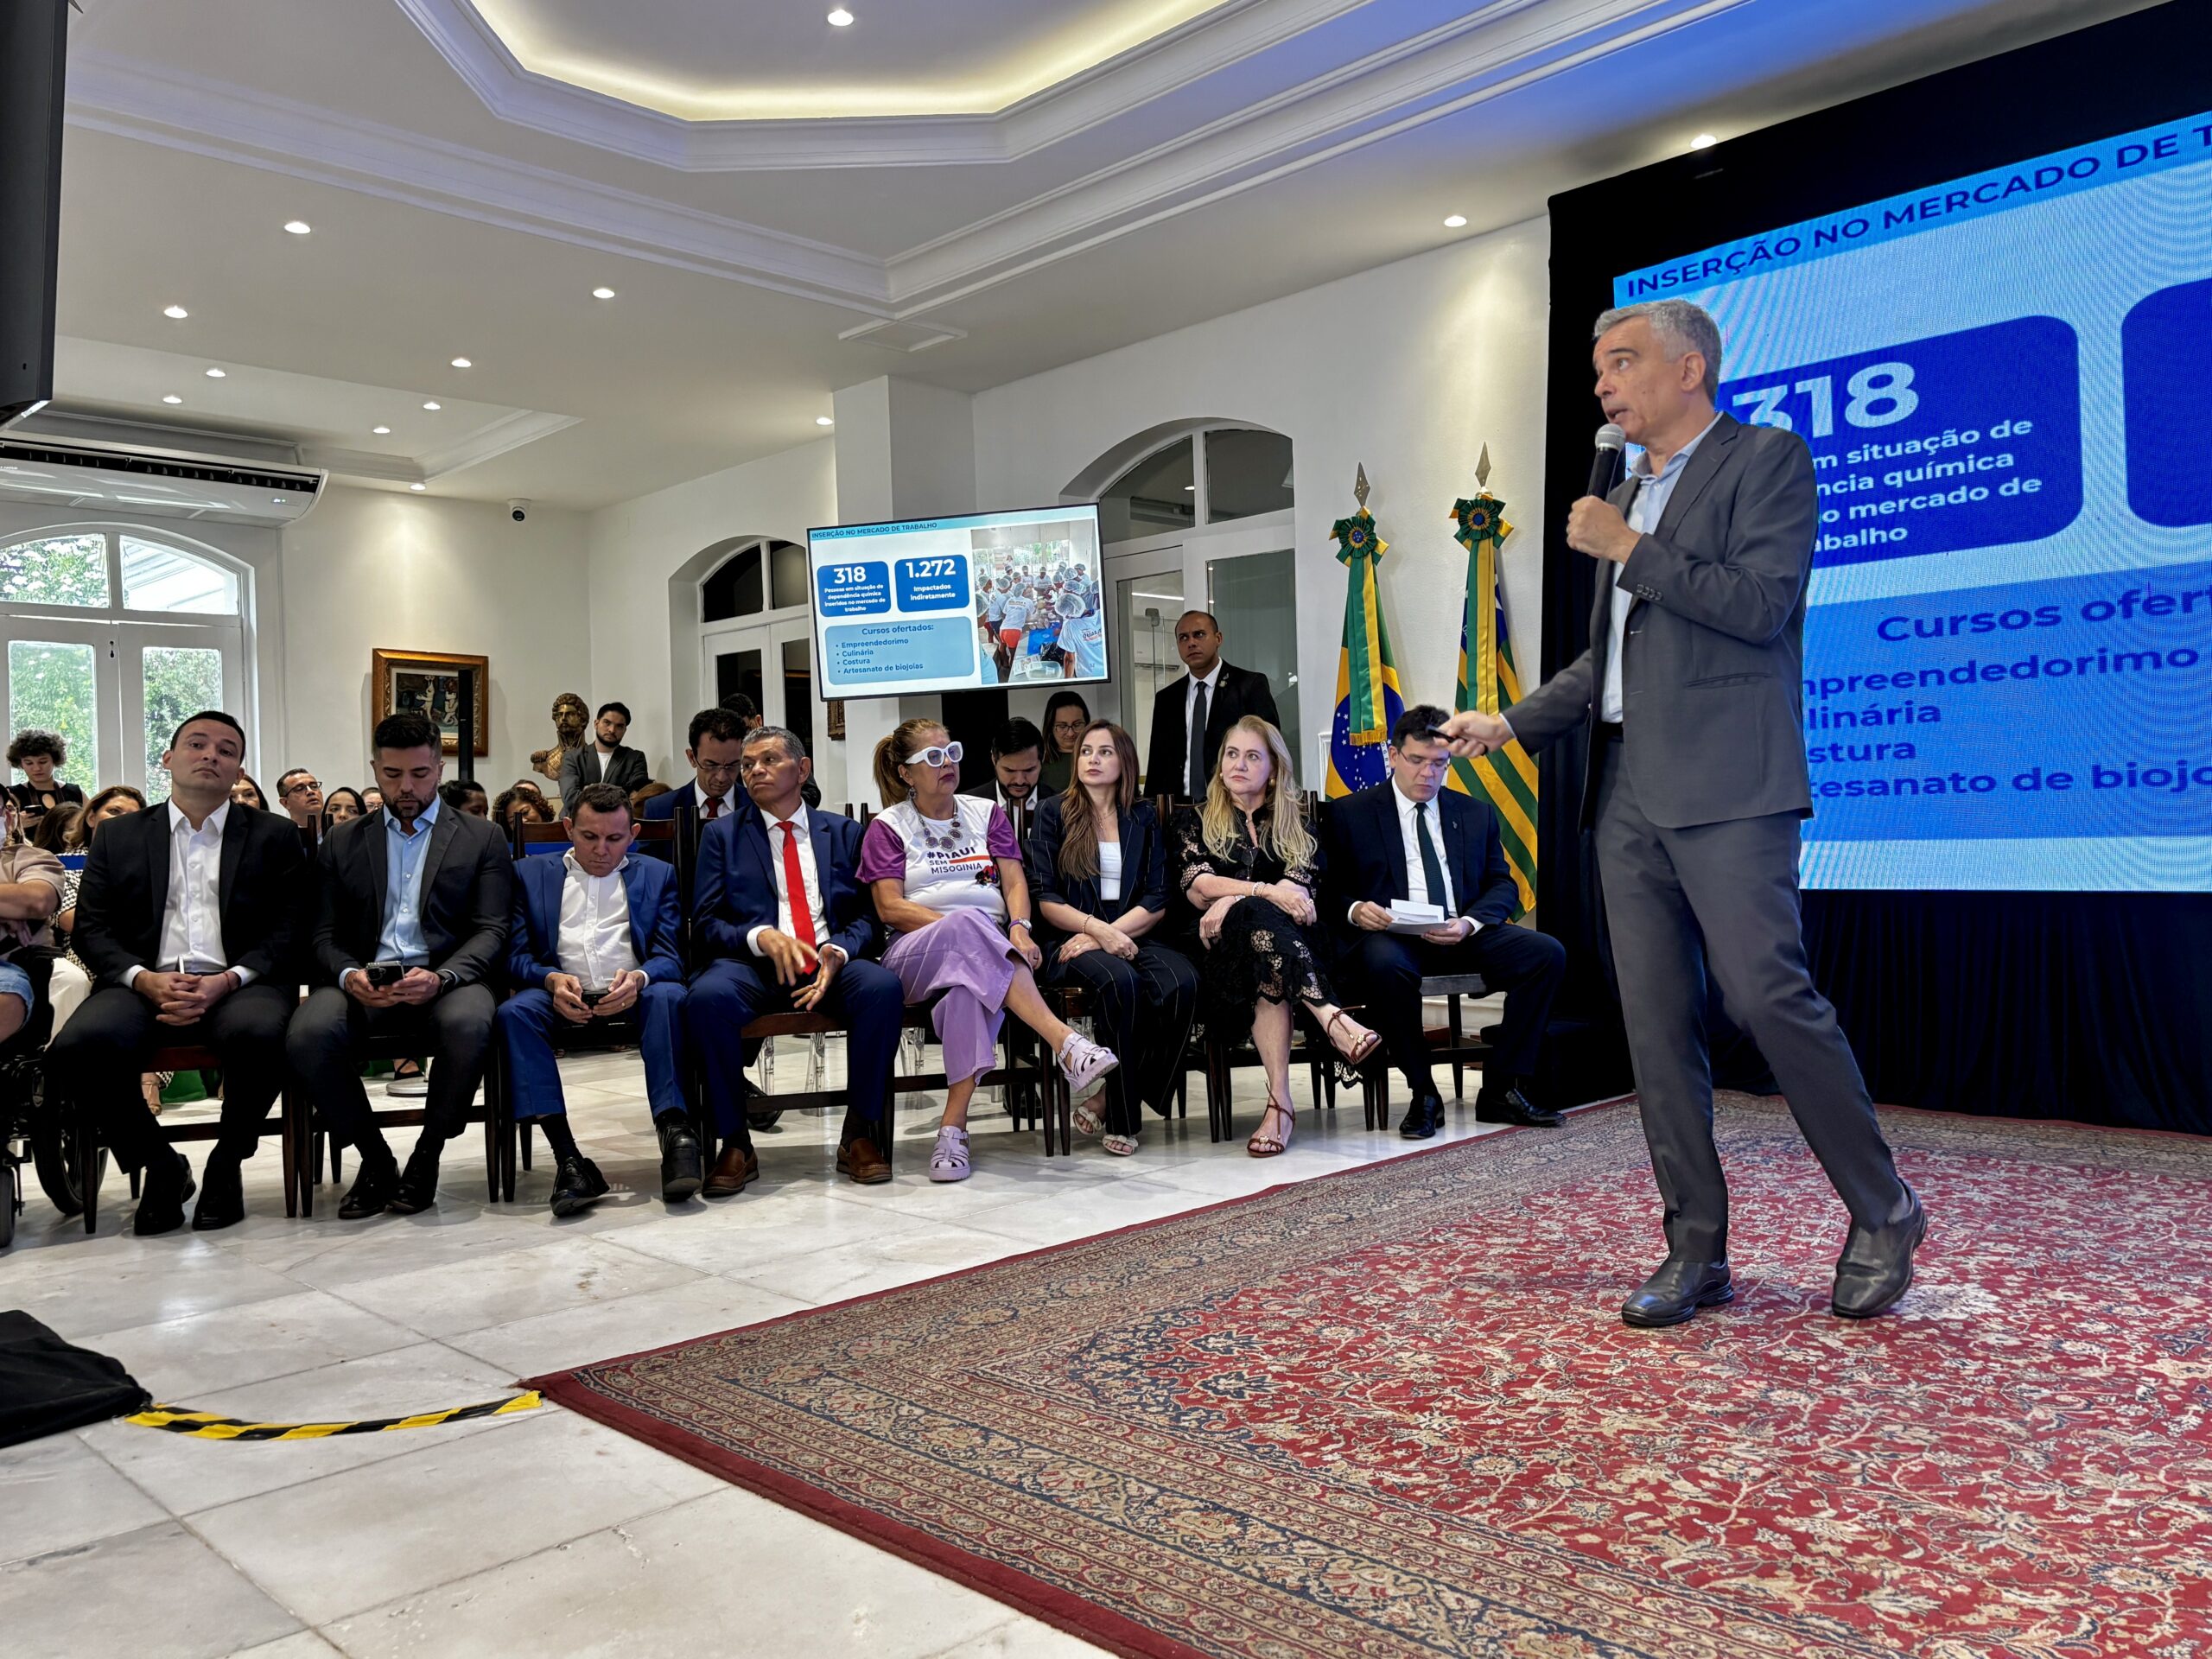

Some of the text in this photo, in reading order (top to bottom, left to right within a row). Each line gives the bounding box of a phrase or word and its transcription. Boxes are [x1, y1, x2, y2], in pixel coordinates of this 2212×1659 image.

[1628, 237, 1802, 297] INSERÇÃO
[1814, 218, 1870, 248] NO
[1883, 156, 2101, 230] MERCADO
[2116, 133, 2179, 168] DE
[1732, 361, 1919, 439] 318
[1813, 418, 2033, 469] m situação de
[1816, 451, 2014, 496] ncia química
[1819, 476, 2043, 523] o mercado de
[811, 530, 844, 538] INSERÇÃO
[902, 522, 938, 531] TRABALHO
[833, 566, 867, 584] 318
[905, 558, 956, 578] 1.272
[861, 624, 934, 635] Cursos ofertados:
[1877, 604, 2063, 642] Cursos
[842, 639, 909, 649] Empreendedorimo
[843, 665, 882, 674] Artesanato
[895, 663, 924, 671] biojoias
[1808, 700, 1941, 730] linária
[1808, 741, 1916, 763] stura
[2012, 766, 2073, 792] de
[931, 862, 982, 874] MISOGINIA
